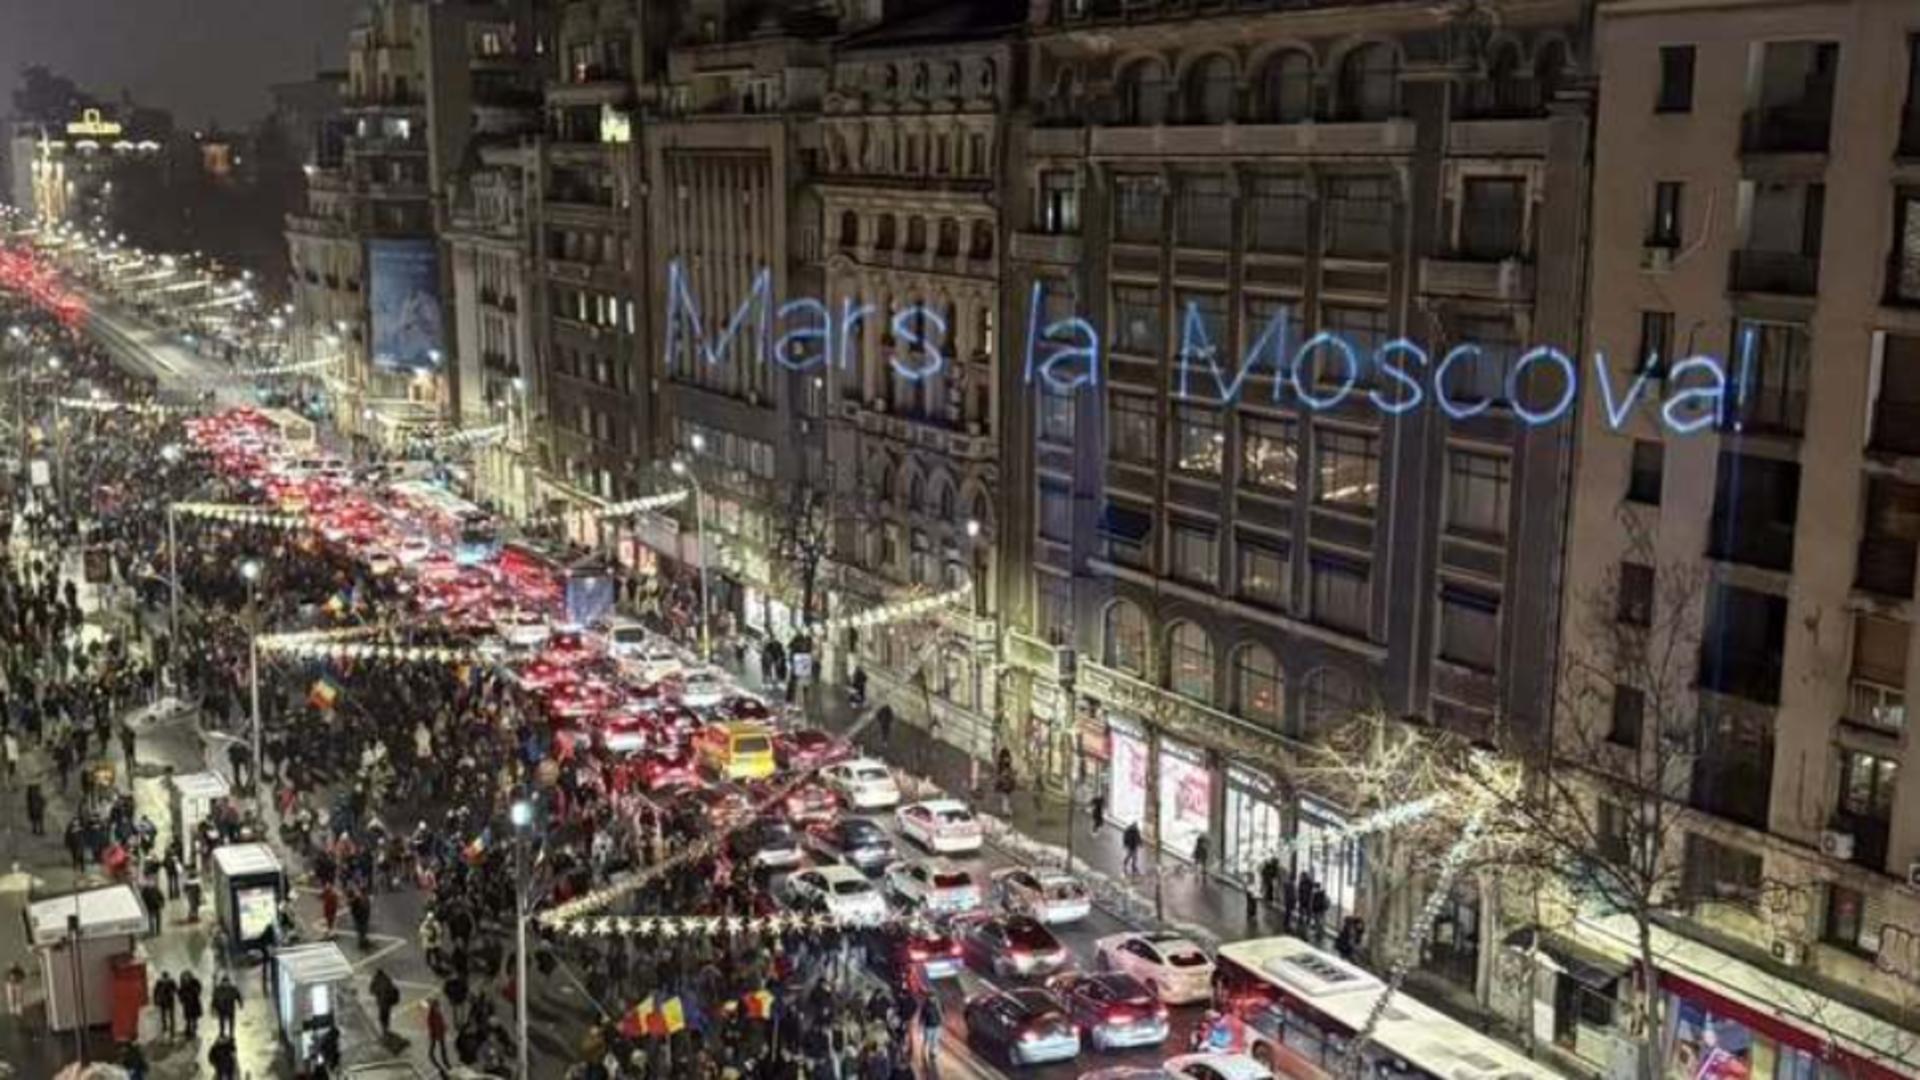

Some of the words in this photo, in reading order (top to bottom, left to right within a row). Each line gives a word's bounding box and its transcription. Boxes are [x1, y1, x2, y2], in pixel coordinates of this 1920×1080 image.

[664, 261, 948, 380] Mars
[1023, 279, 1099, 390] la
[1177, 299, 1753, 433] Moscova!
